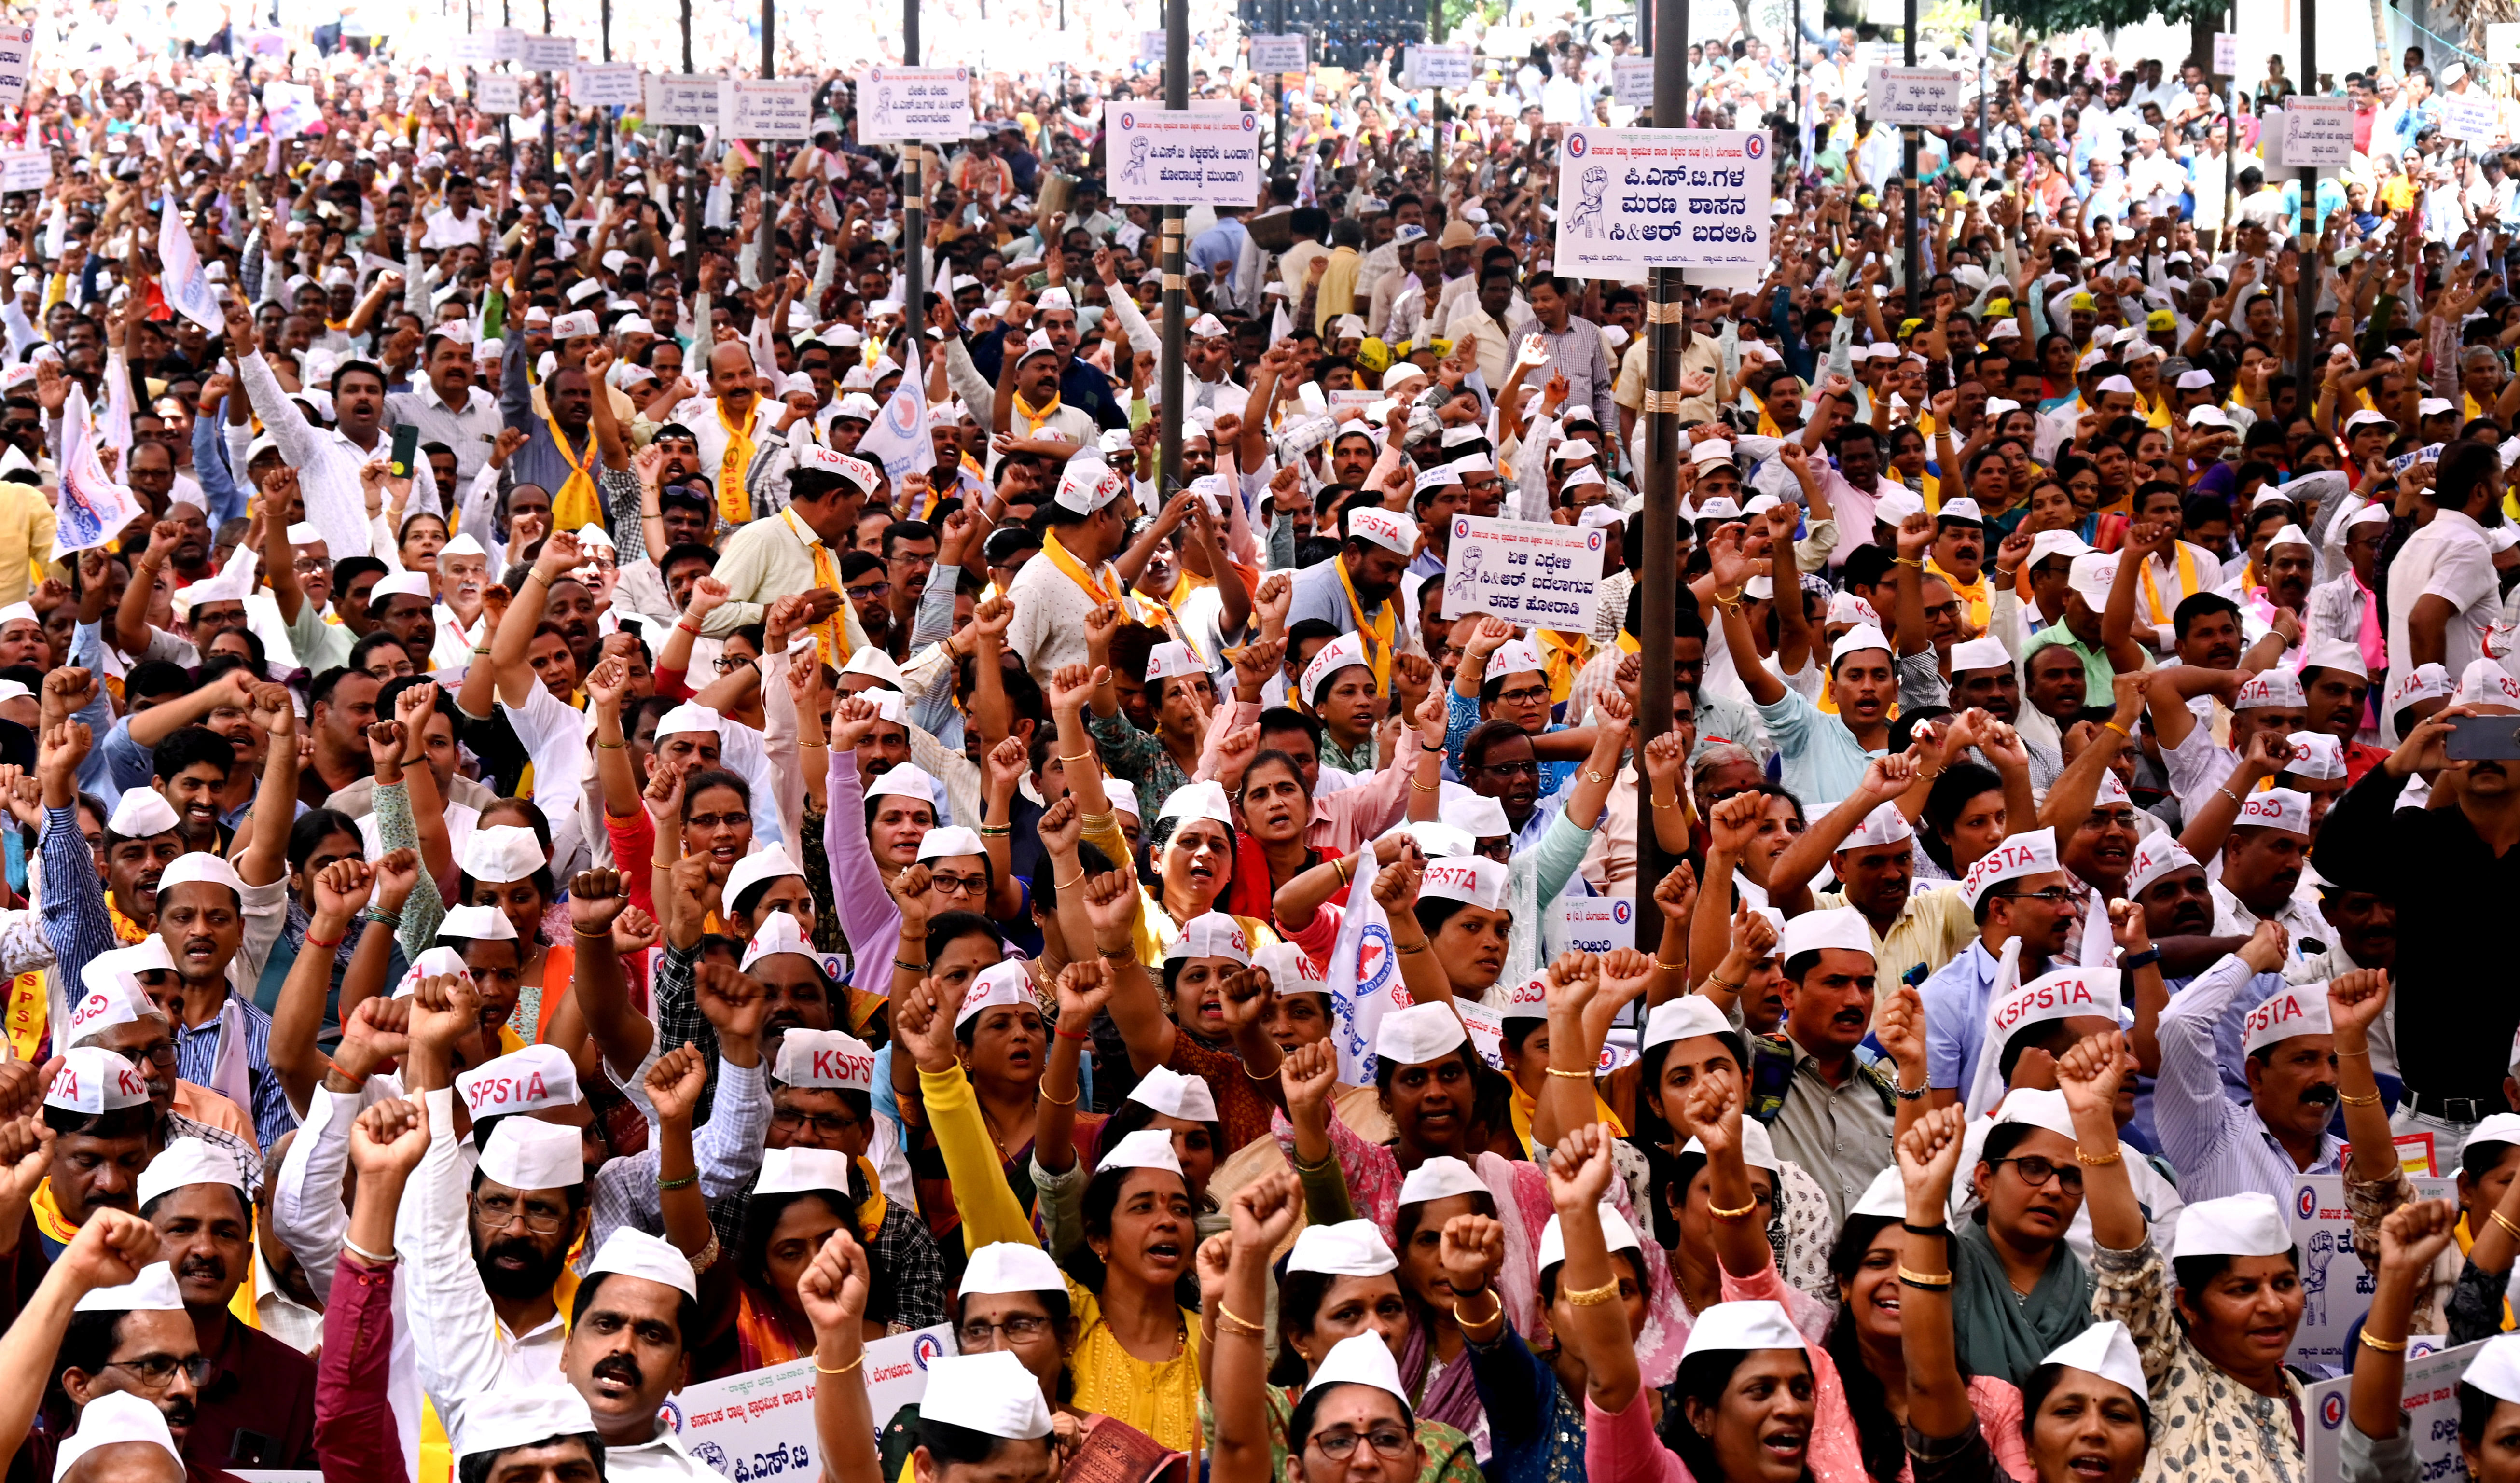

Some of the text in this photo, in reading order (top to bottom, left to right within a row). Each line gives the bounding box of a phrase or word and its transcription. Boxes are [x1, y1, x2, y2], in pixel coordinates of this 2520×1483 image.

[1224, 147, 1254, 160] ಒಂದಾಗಿ
[1207, 170, 1244, 182] ಮುಂದಾಗಿ
[1625, 165, 1745, 187] ಪಿ.ಎಸ್.ಟಿ.ಗಳ
[1622, 192, 1746, 215] ಮರಣ ಶಾಸನ
[1610, 221, 1757, 242] ಸಿ&ಆರ್ ಬದಲಿಸಿ
[816, 450, 870, 487] KSPSTA
[1508, 551, 1572, 574] ಏಳಿ ಎದ್ದೇಳಿ
[1480, 571, 1594, 594] ಸಿ&ಆರ್ ಬದಲಾಗುವ
[1489, 593, 1579, 615] ತನಕ ಹೋರಾಡಿ
[2395, 674, 2424, 700] STA
[1994, 981, 2093, 1032] KSPSTA
[690, 1363, 913, 1428] ಕರ್ನಾಟಕ ರಾಜ್ಯ ಪ್ರಾಥಮಿಕ ಶಾಲಾ ಬೆಂಗಳೂರು
